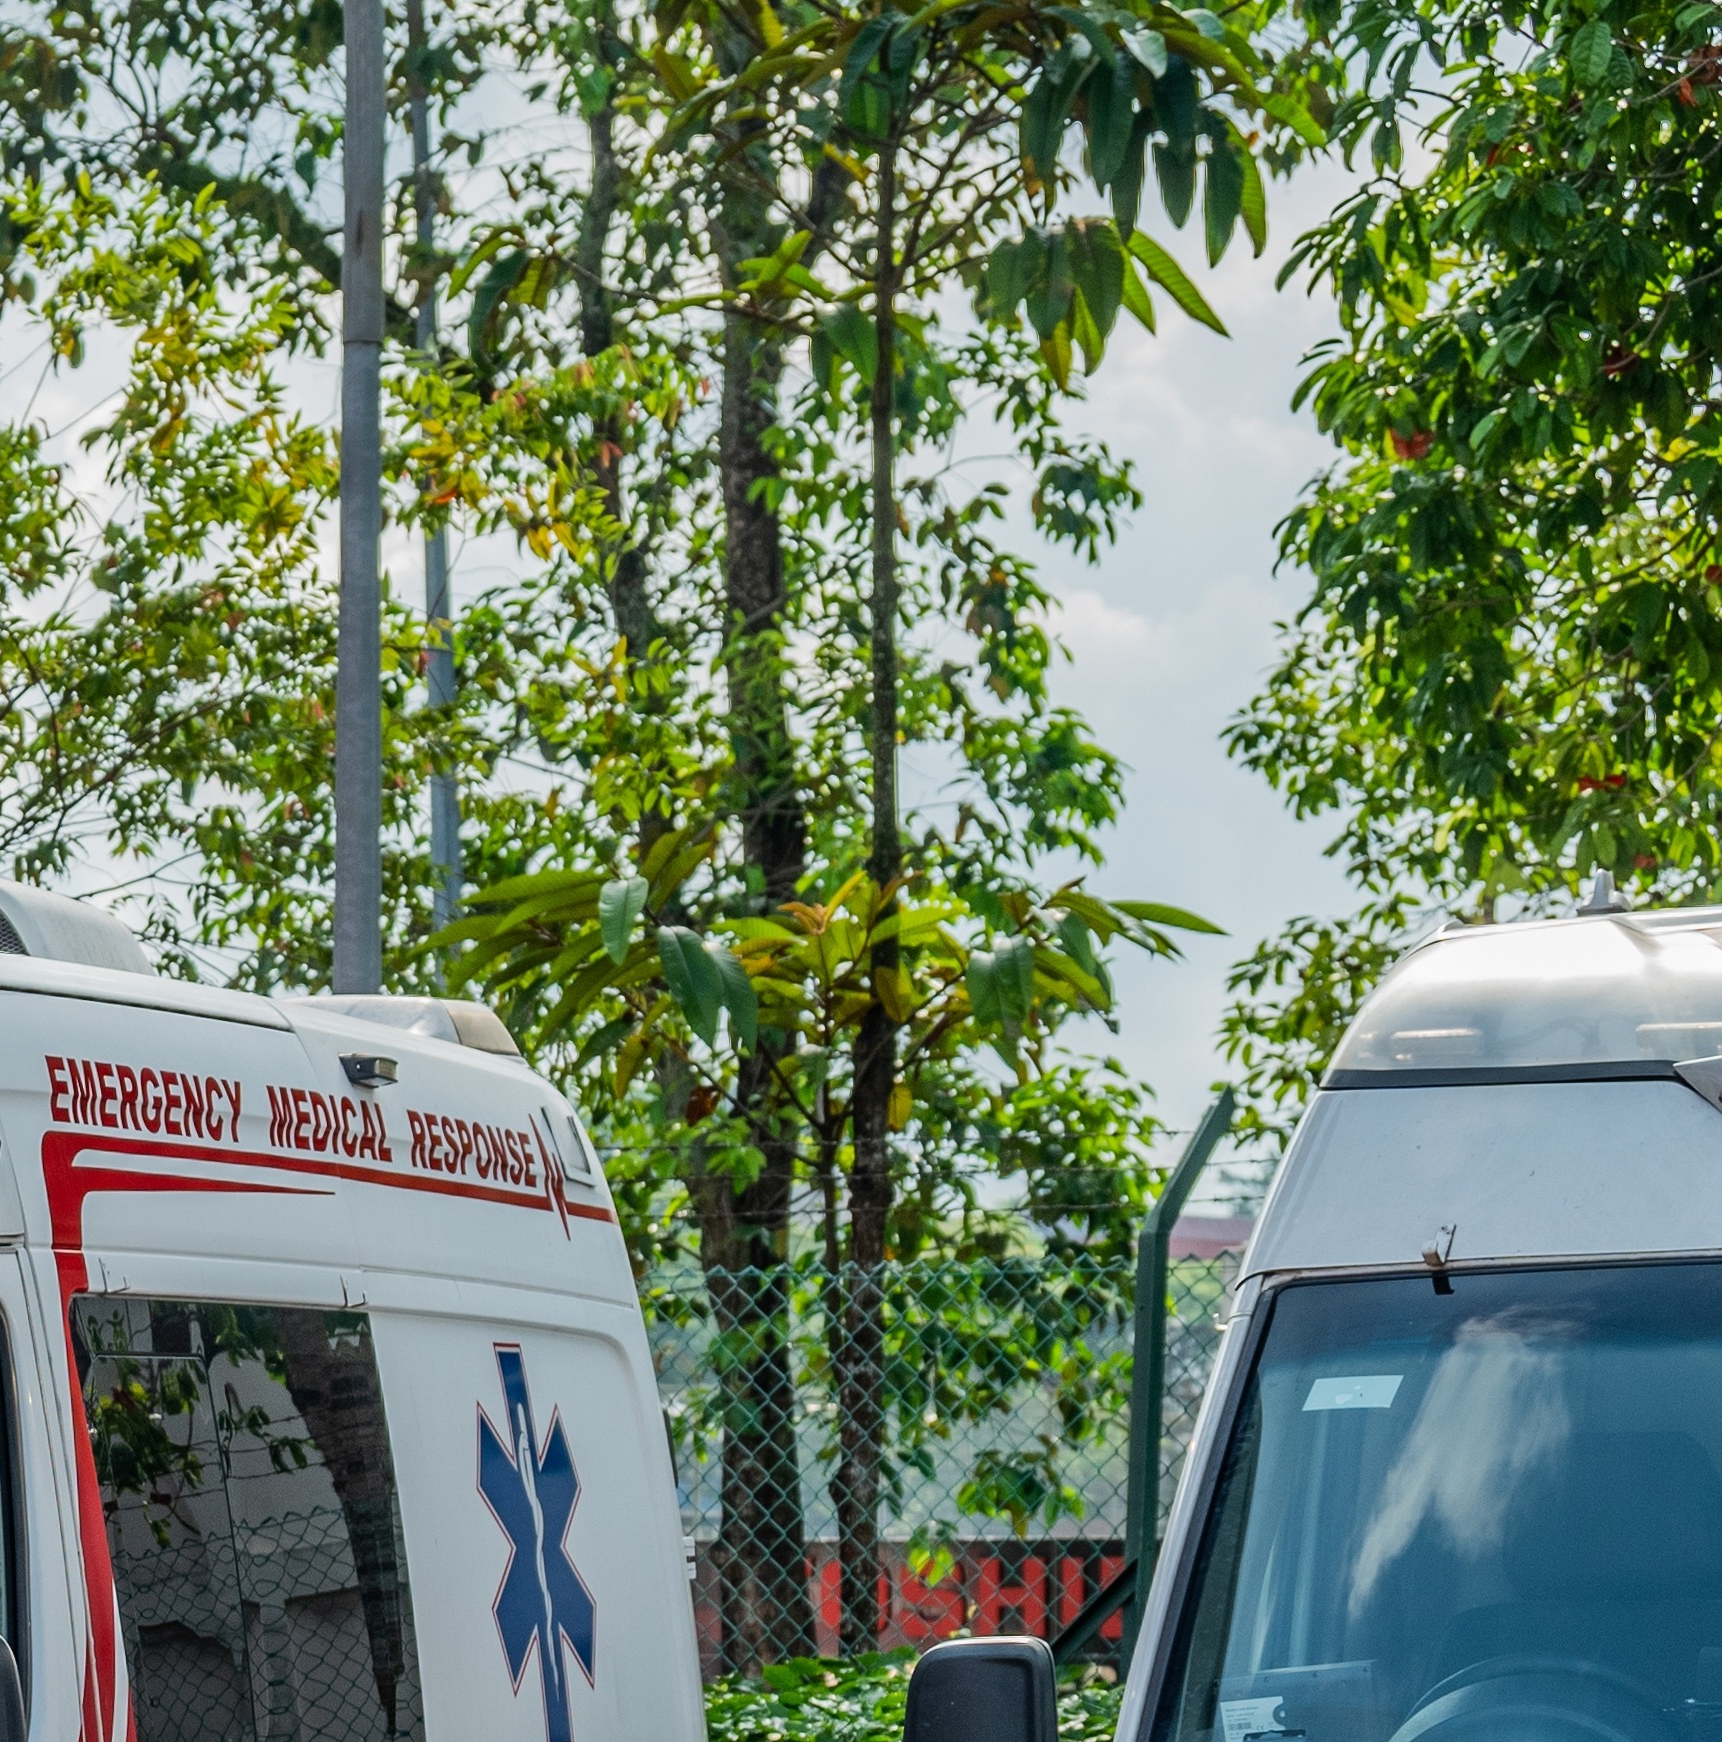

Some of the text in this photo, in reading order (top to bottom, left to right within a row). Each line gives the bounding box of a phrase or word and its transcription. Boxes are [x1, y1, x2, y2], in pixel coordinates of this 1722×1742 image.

[44, 1053, 538, 1189] EMERGENCY MEDICAL RESPONSE
